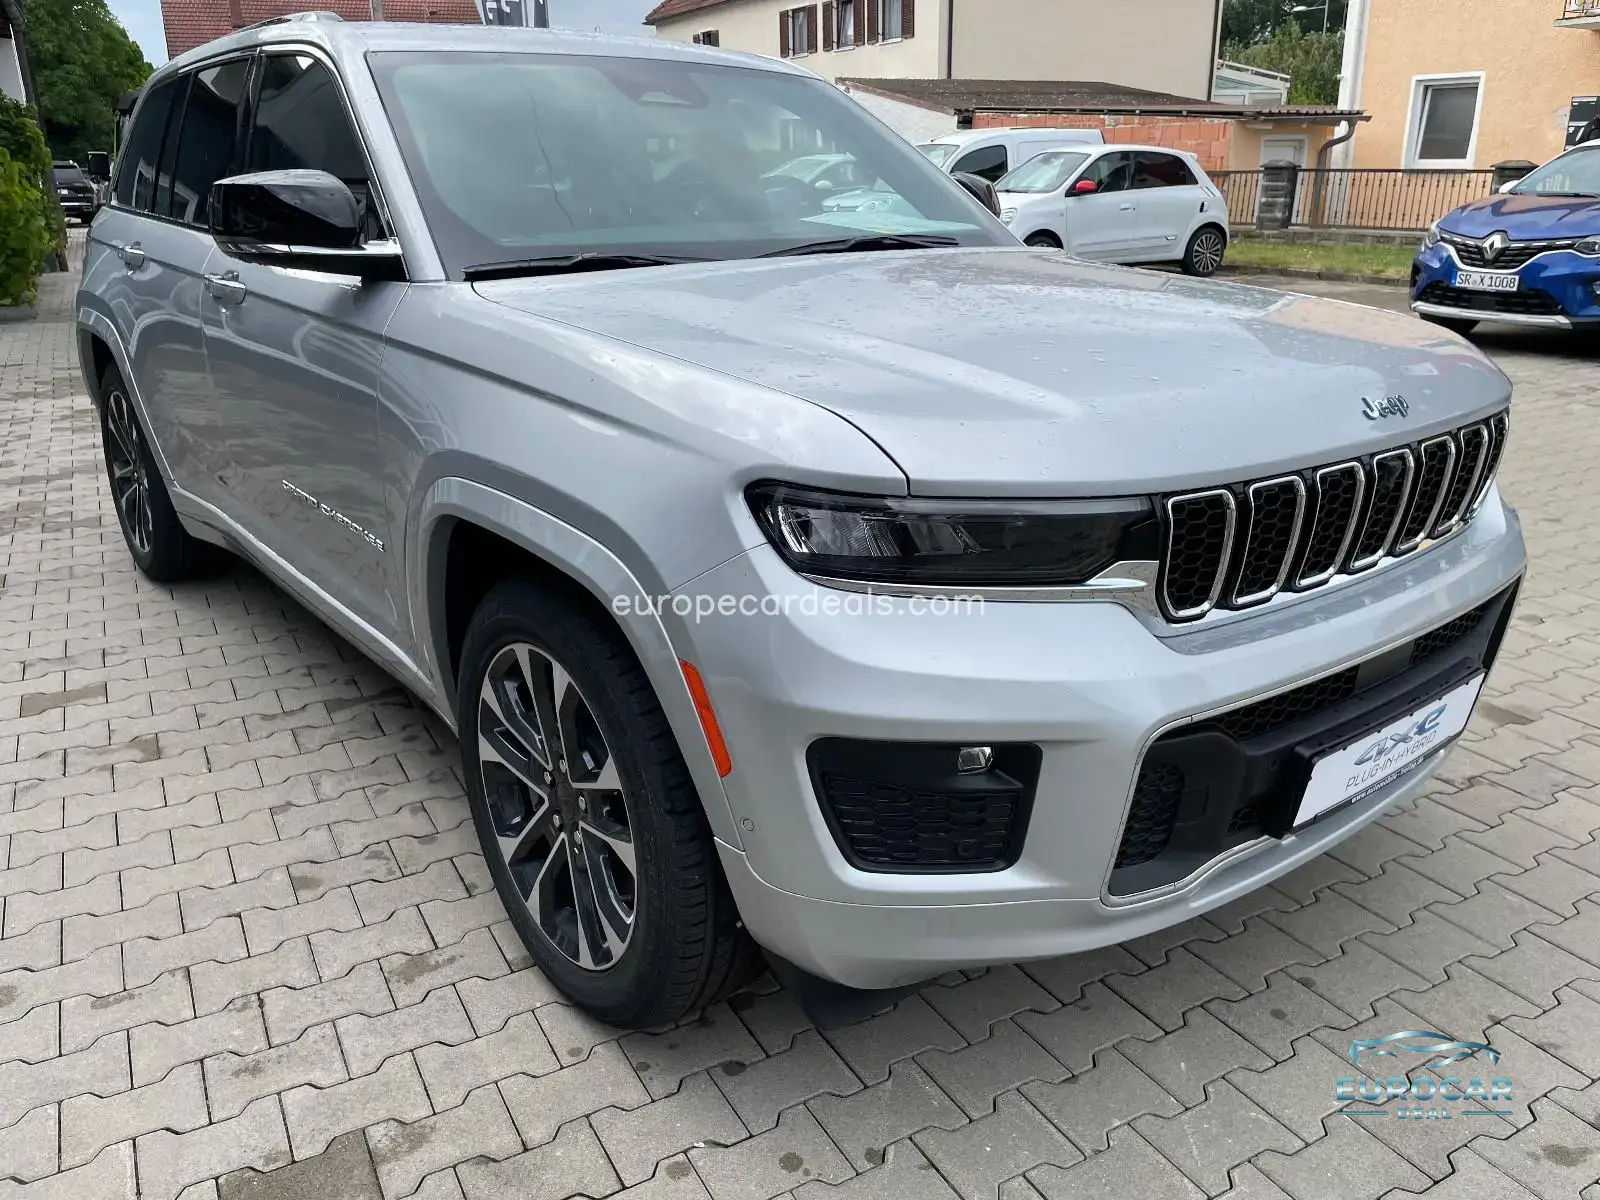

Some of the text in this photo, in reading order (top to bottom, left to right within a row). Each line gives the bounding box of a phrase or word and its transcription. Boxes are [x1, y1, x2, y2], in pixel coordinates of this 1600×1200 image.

[1457, 273, 1516, 289] SR X 1008
[1361, 394, 1410, 421] Jeep
[1345, 729, 1437, 792] PLUG-IN-HYBRID
